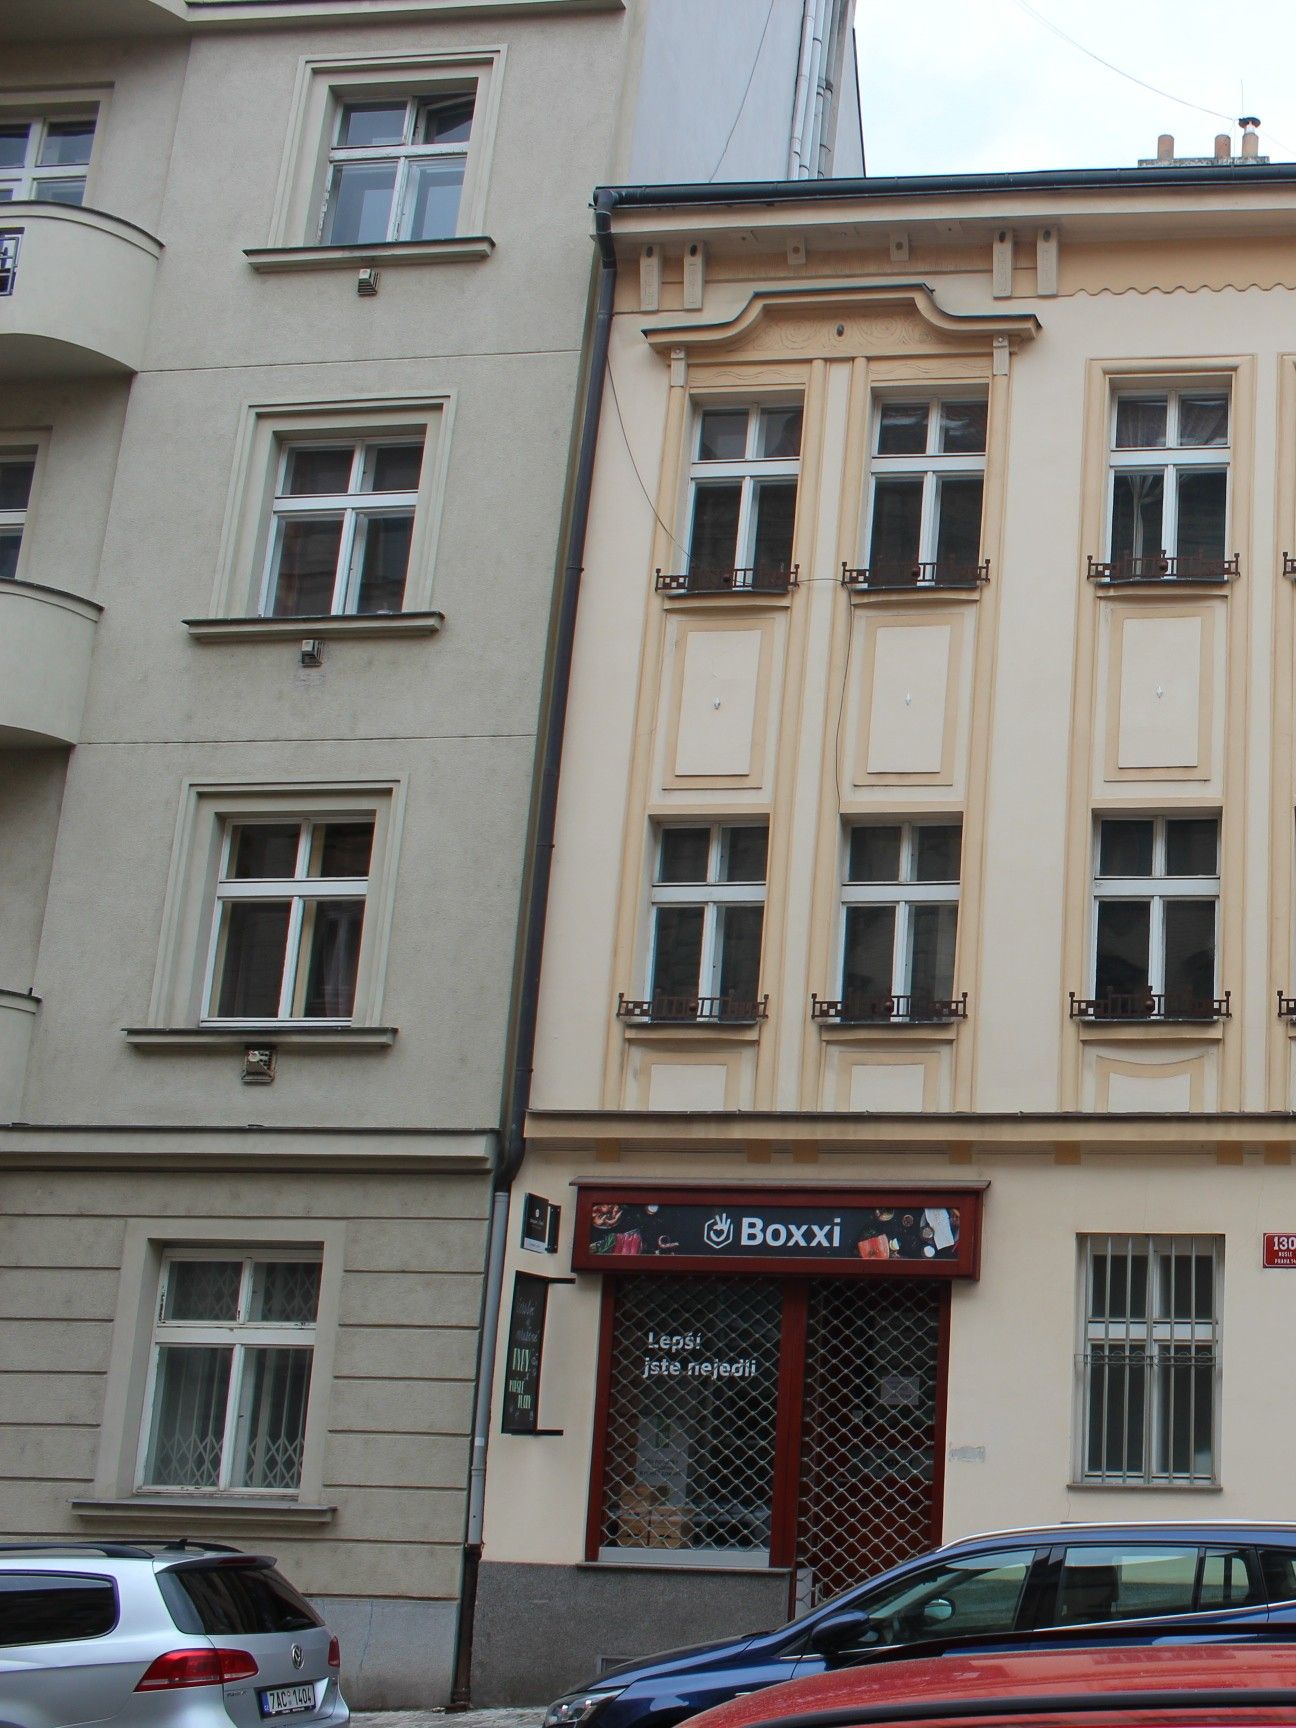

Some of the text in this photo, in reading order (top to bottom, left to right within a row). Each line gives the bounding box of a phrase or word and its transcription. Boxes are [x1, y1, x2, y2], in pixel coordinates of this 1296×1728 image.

[741, 1217, 841, 1247] Boxxi
[1273, 1236, 1296, 1250] 130
[642, 1357, 756, 1380] jste nejedli
[270, 1691, 288, 1710] 7AC
[292, 1687, 312, 1706] 1404
